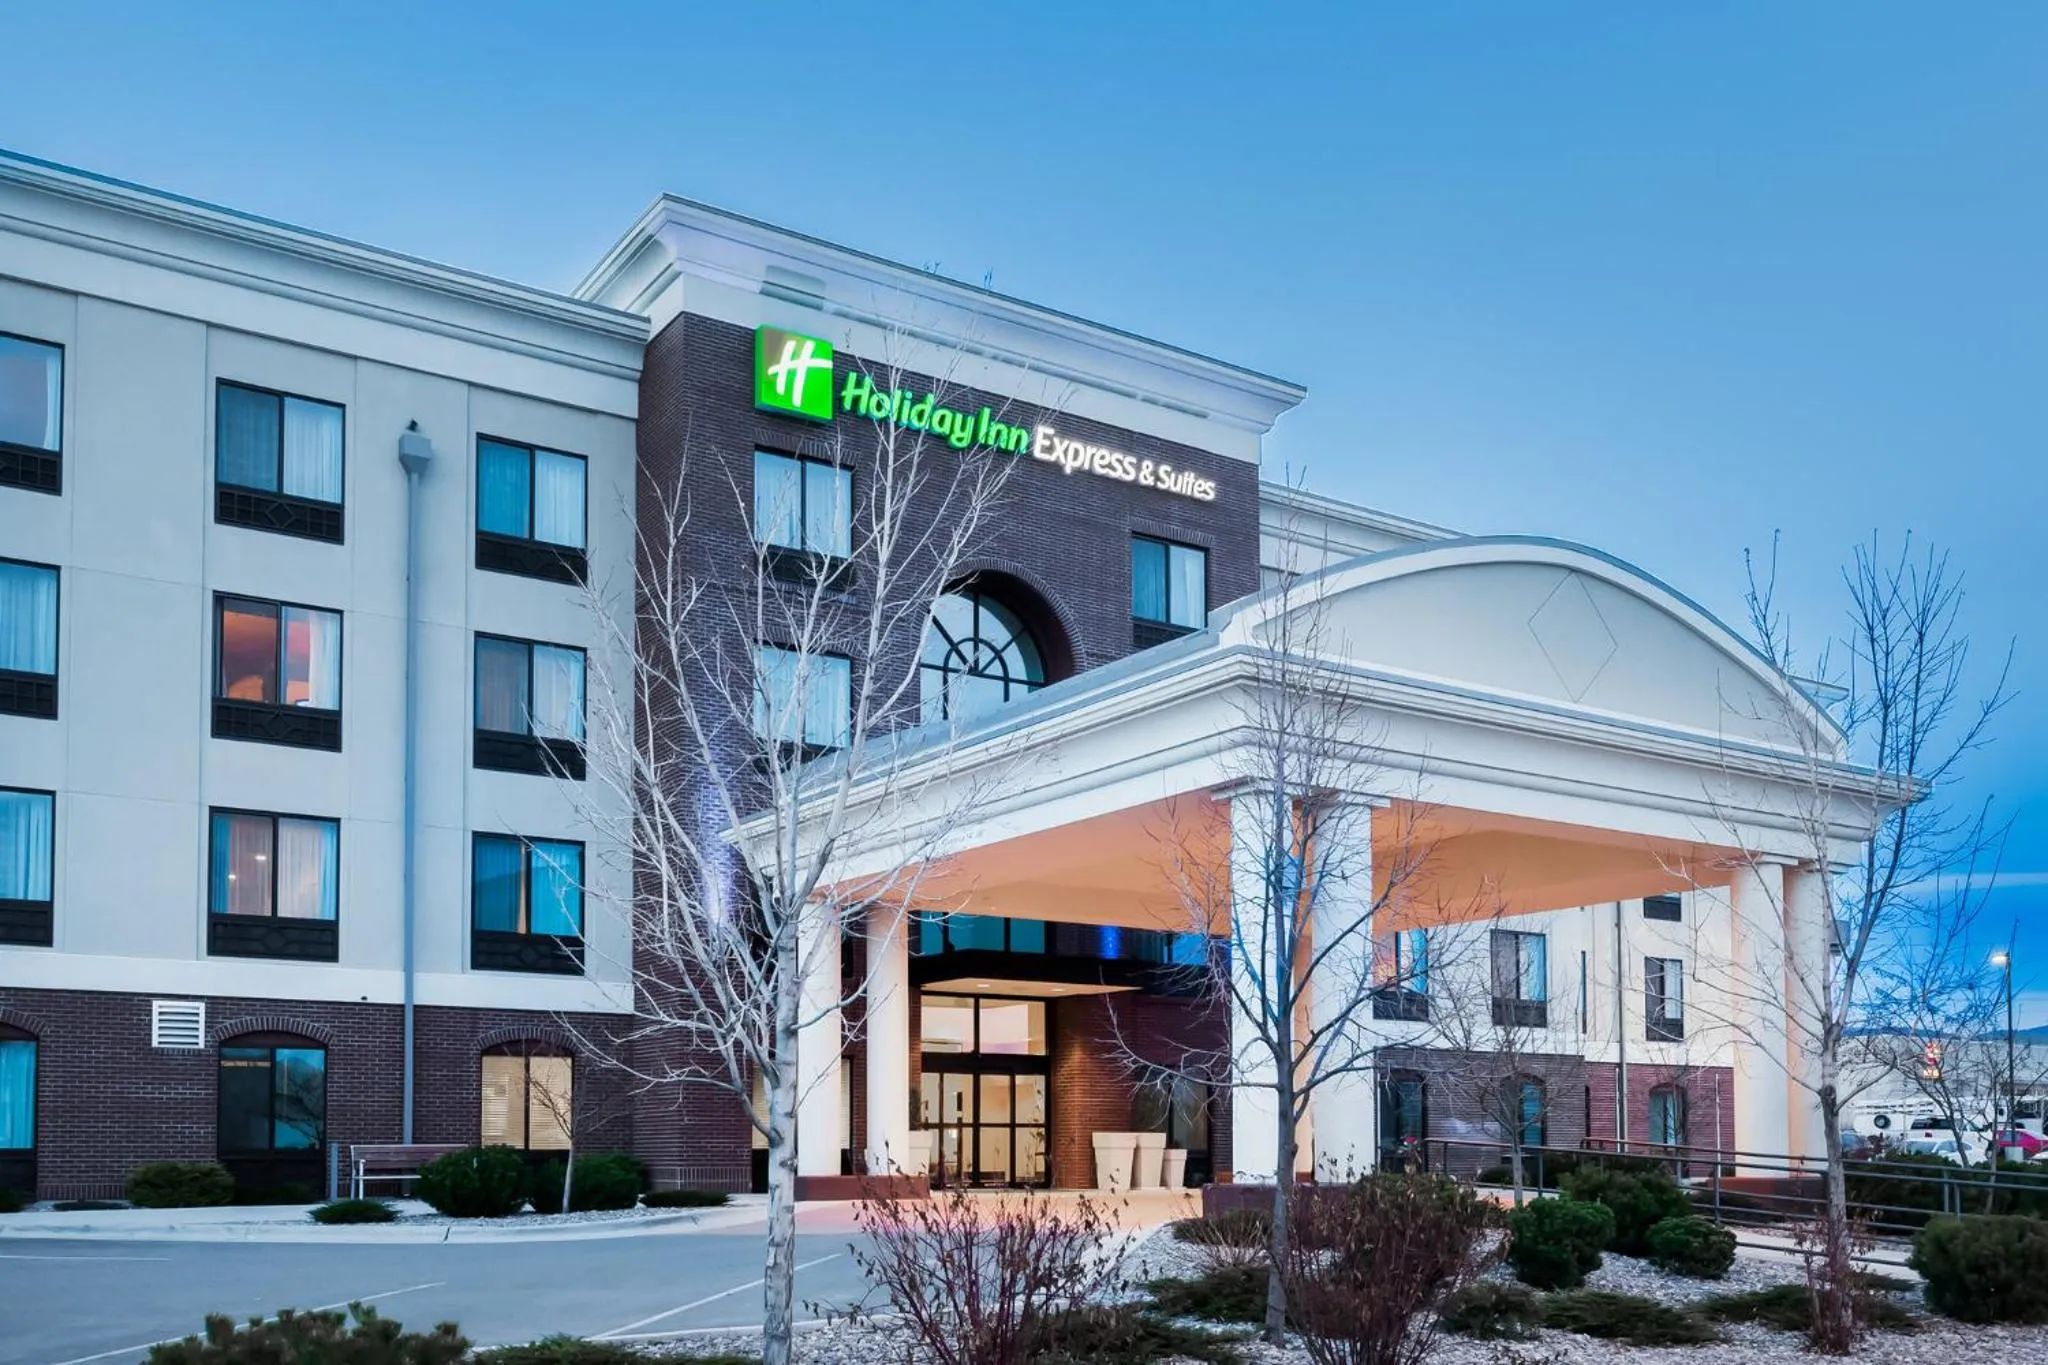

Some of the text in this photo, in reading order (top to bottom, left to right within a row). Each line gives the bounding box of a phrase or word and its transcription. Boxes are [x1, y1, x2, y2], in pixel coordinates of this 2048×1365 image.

[841, 371, 1217, 501] Holiday Inn Express & Suites
